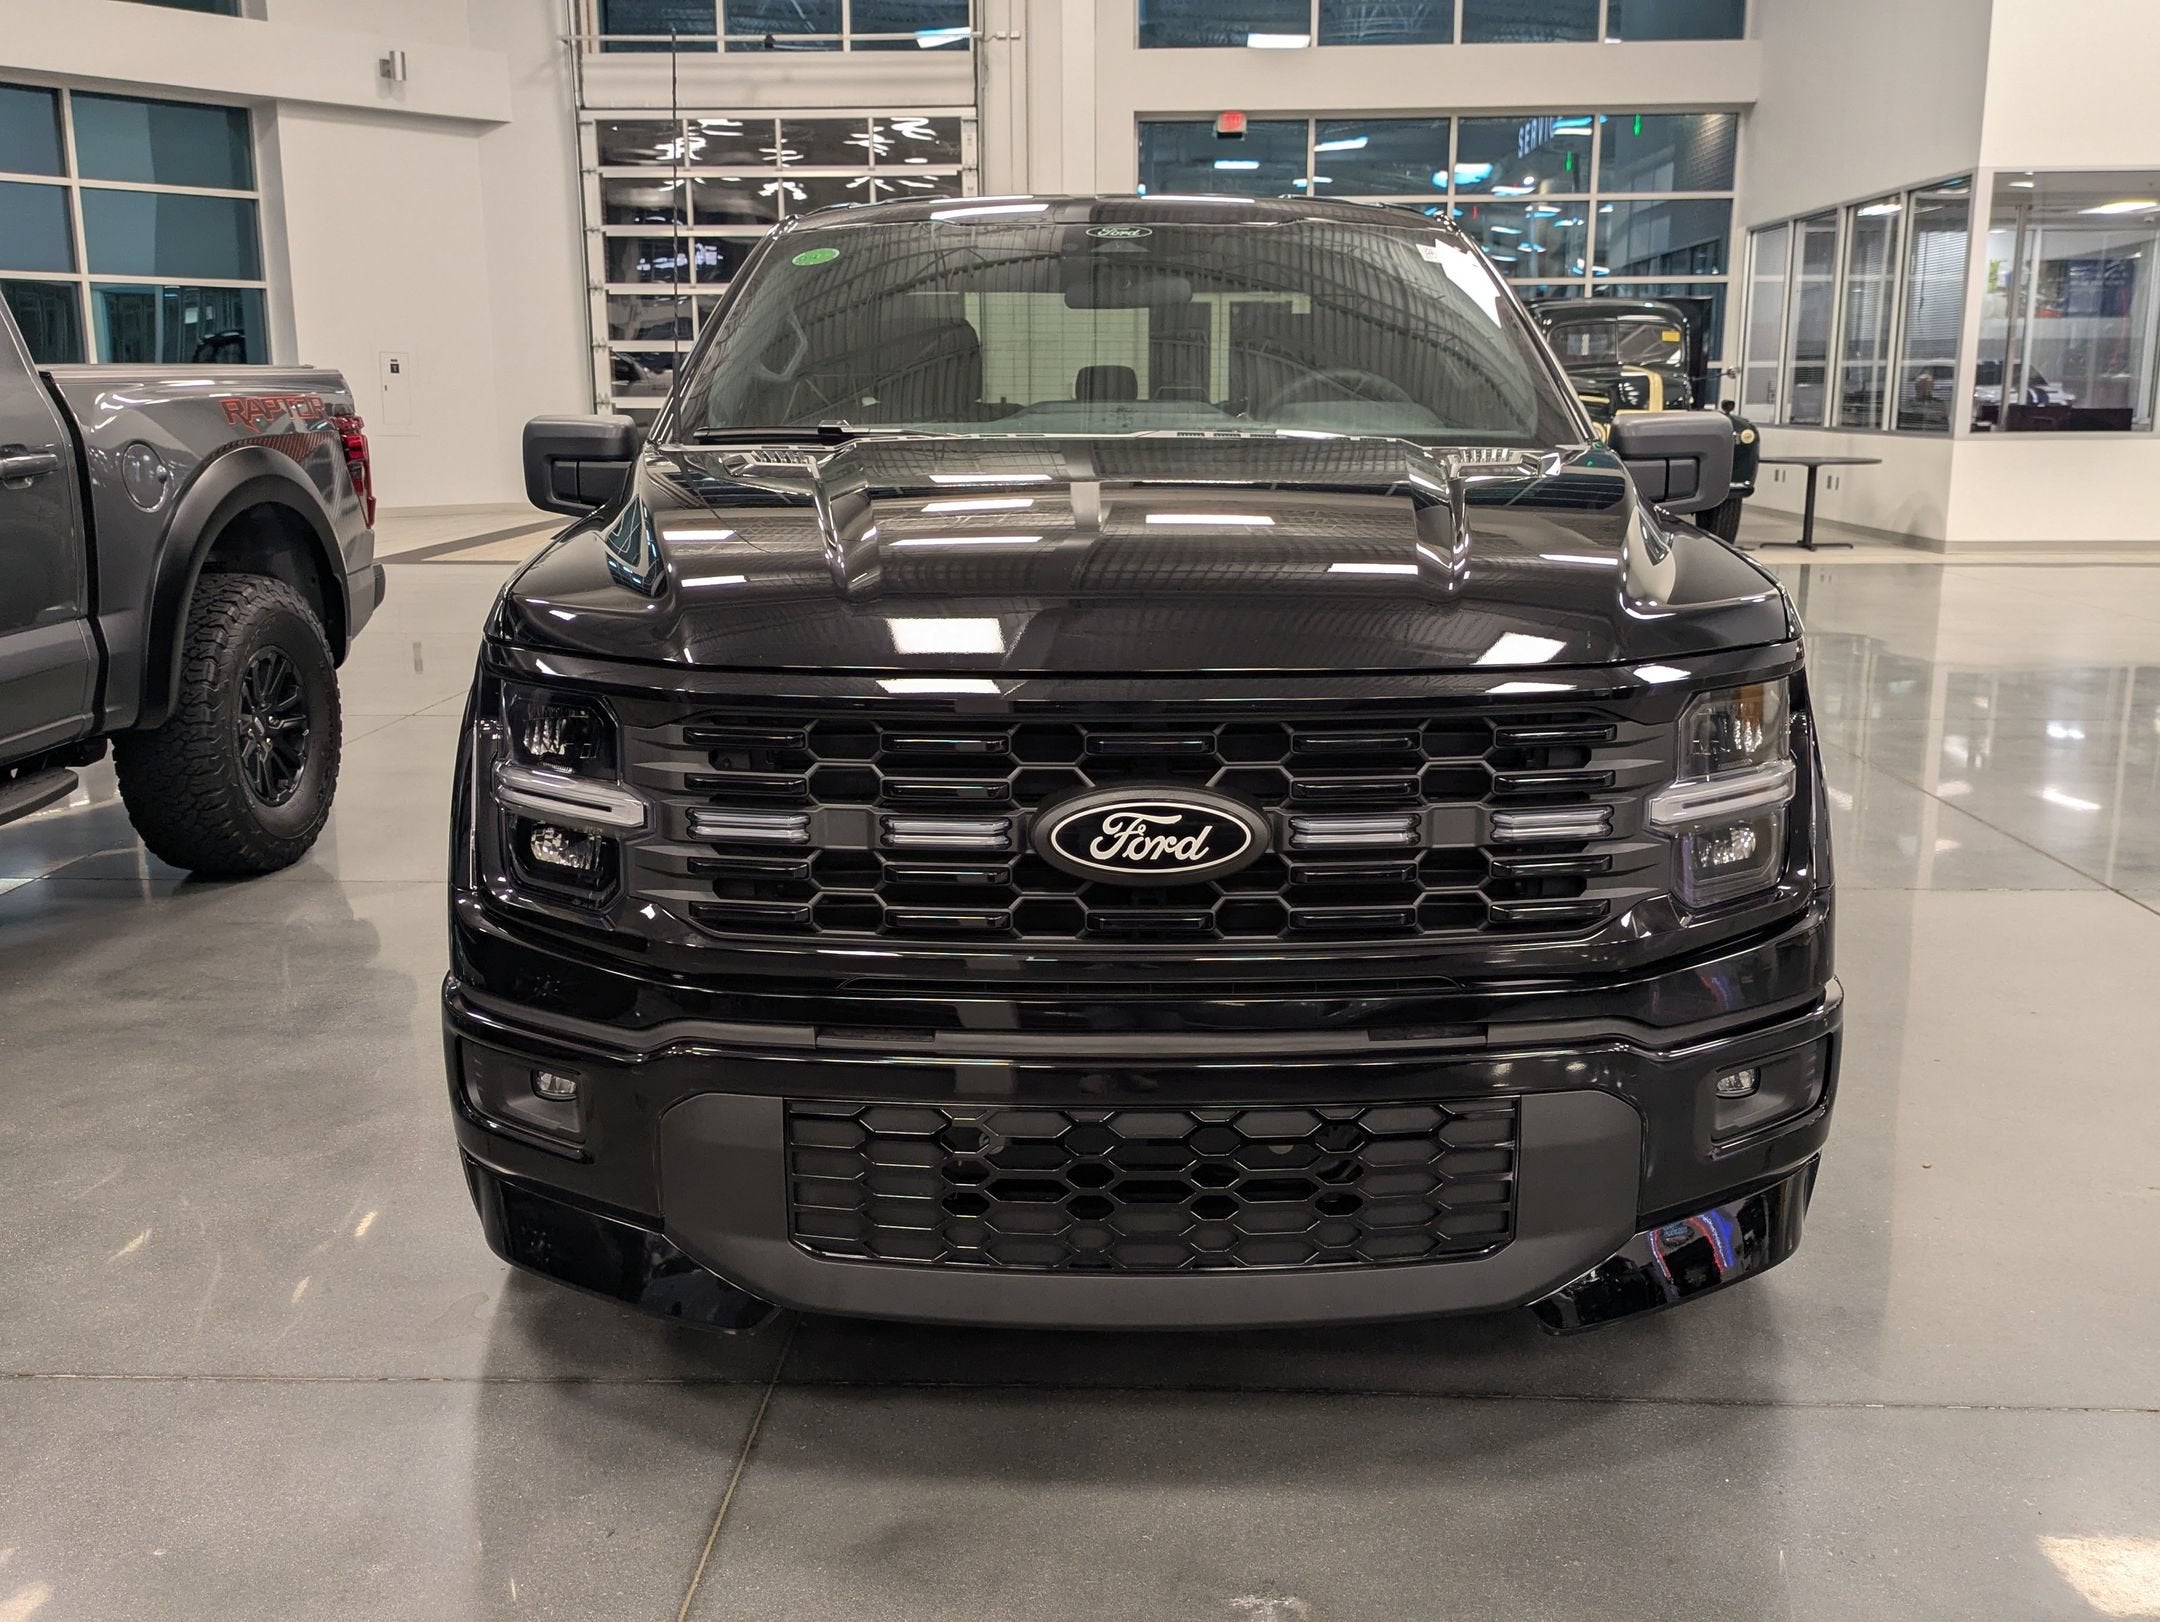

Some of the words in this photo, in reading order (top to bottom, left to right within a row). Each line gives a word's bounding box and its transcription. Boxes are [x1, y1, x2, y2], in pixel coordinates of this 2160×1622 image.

[1097, 227, 1141, 236] Ford
[218, 394, 332, 434] RAPTOR
[1089, 812, 1213, 861] Ford
